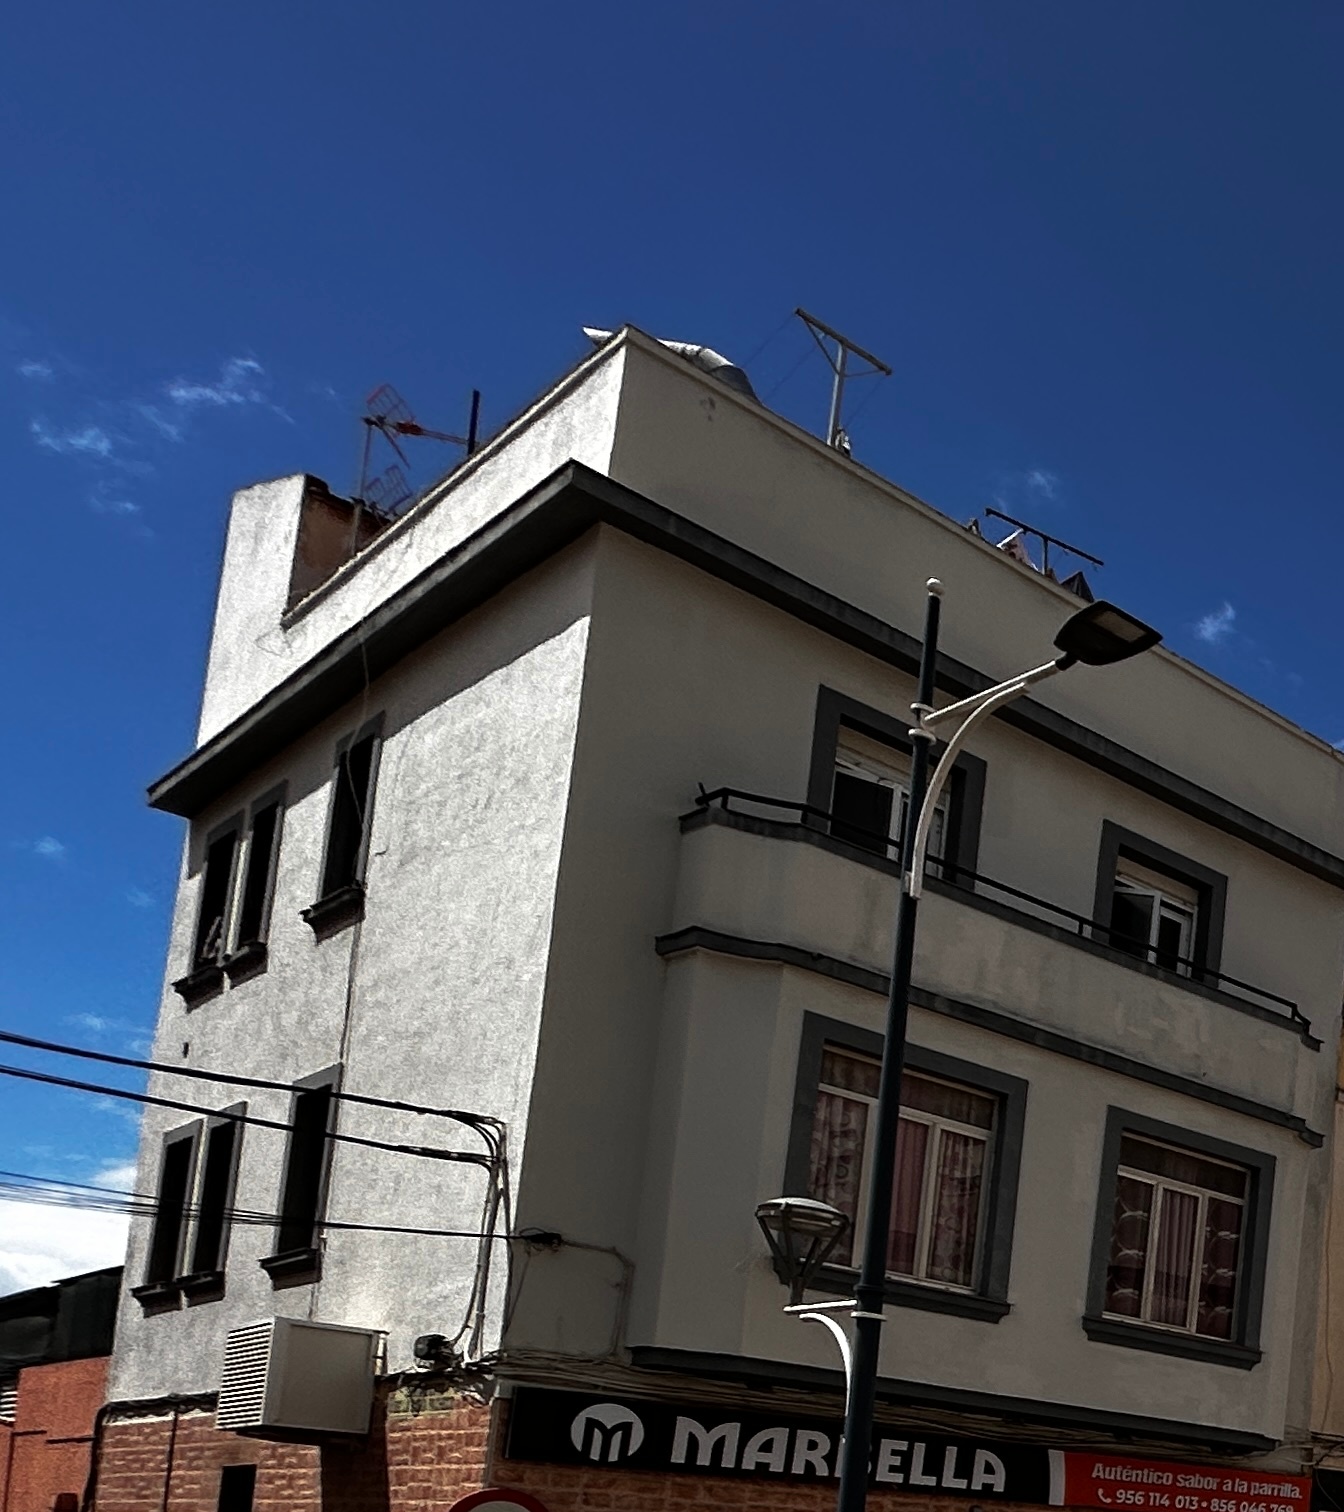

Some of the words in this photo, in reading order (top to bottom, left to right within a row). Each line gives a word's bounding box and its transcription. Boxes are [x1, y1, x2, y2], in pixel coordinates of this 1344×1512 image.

[670, 1415, 1006, 1493] MARELLA
[1092, 1463, 1173, 1486] Auténtico
[1176, 1474, 1220, 1491] sabor
[1222, 1479, 1232, 1492] a
[1234, 1478, 1248, 1493] la
[1116, 1489, 1145, 1505] 956
[1148, 1492, 1170, 1507] 114
[1175, 1496, 1199, 1511] 013
[1210, 1499, 1236, 1512] 856
